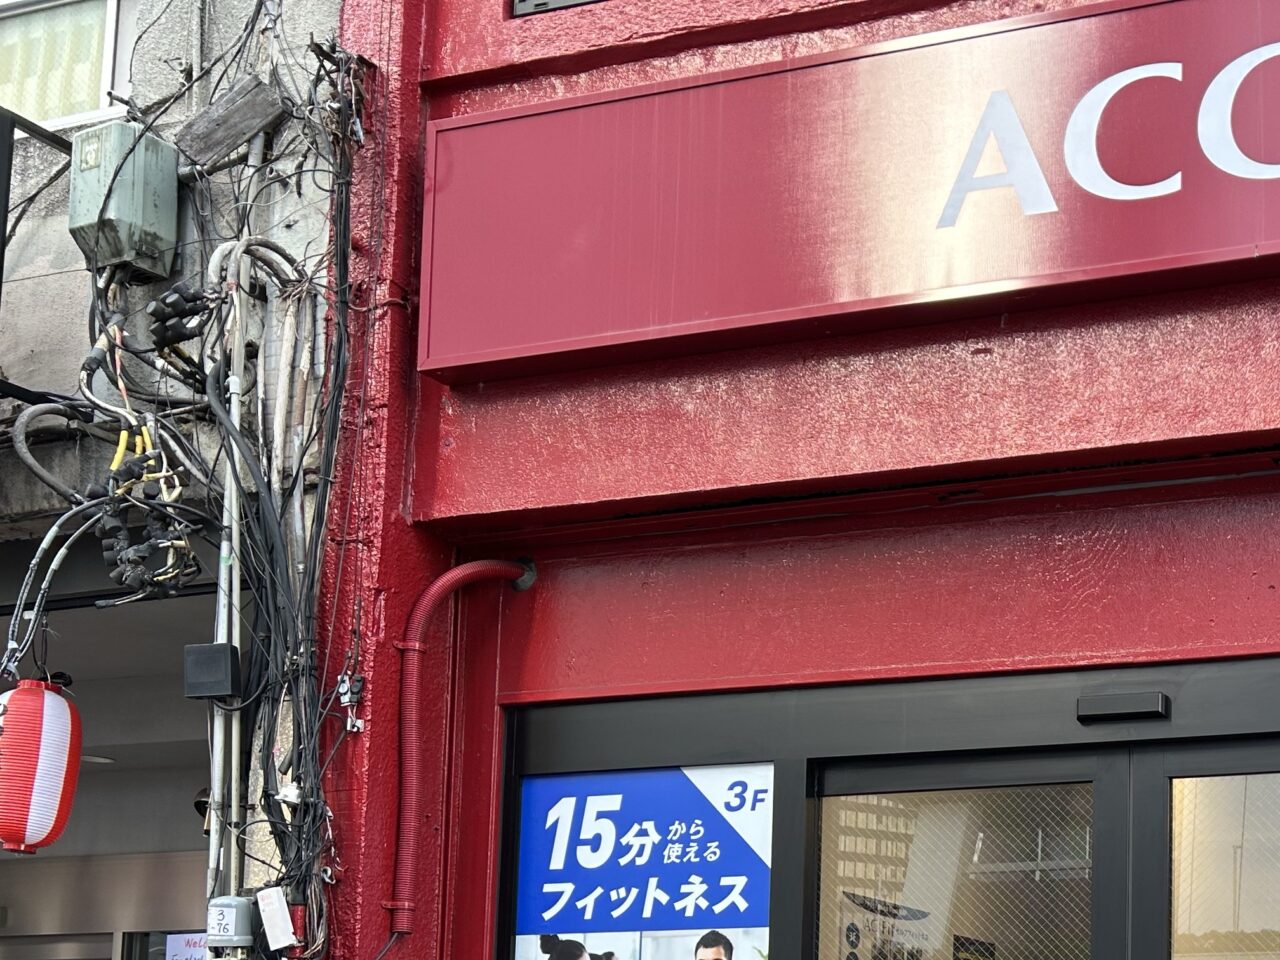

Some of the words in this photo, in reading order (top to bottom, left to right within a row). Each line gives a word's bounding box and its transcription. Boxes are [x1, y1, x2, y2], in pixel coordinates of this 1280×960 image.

[724, 780, 768, 812] 3F
[544, 794, 662, 870] 15分
[667, 819, 705, 841] から
[663, 842, 721, 864] 使える
[541, 874, 750, 921] フィットネス
